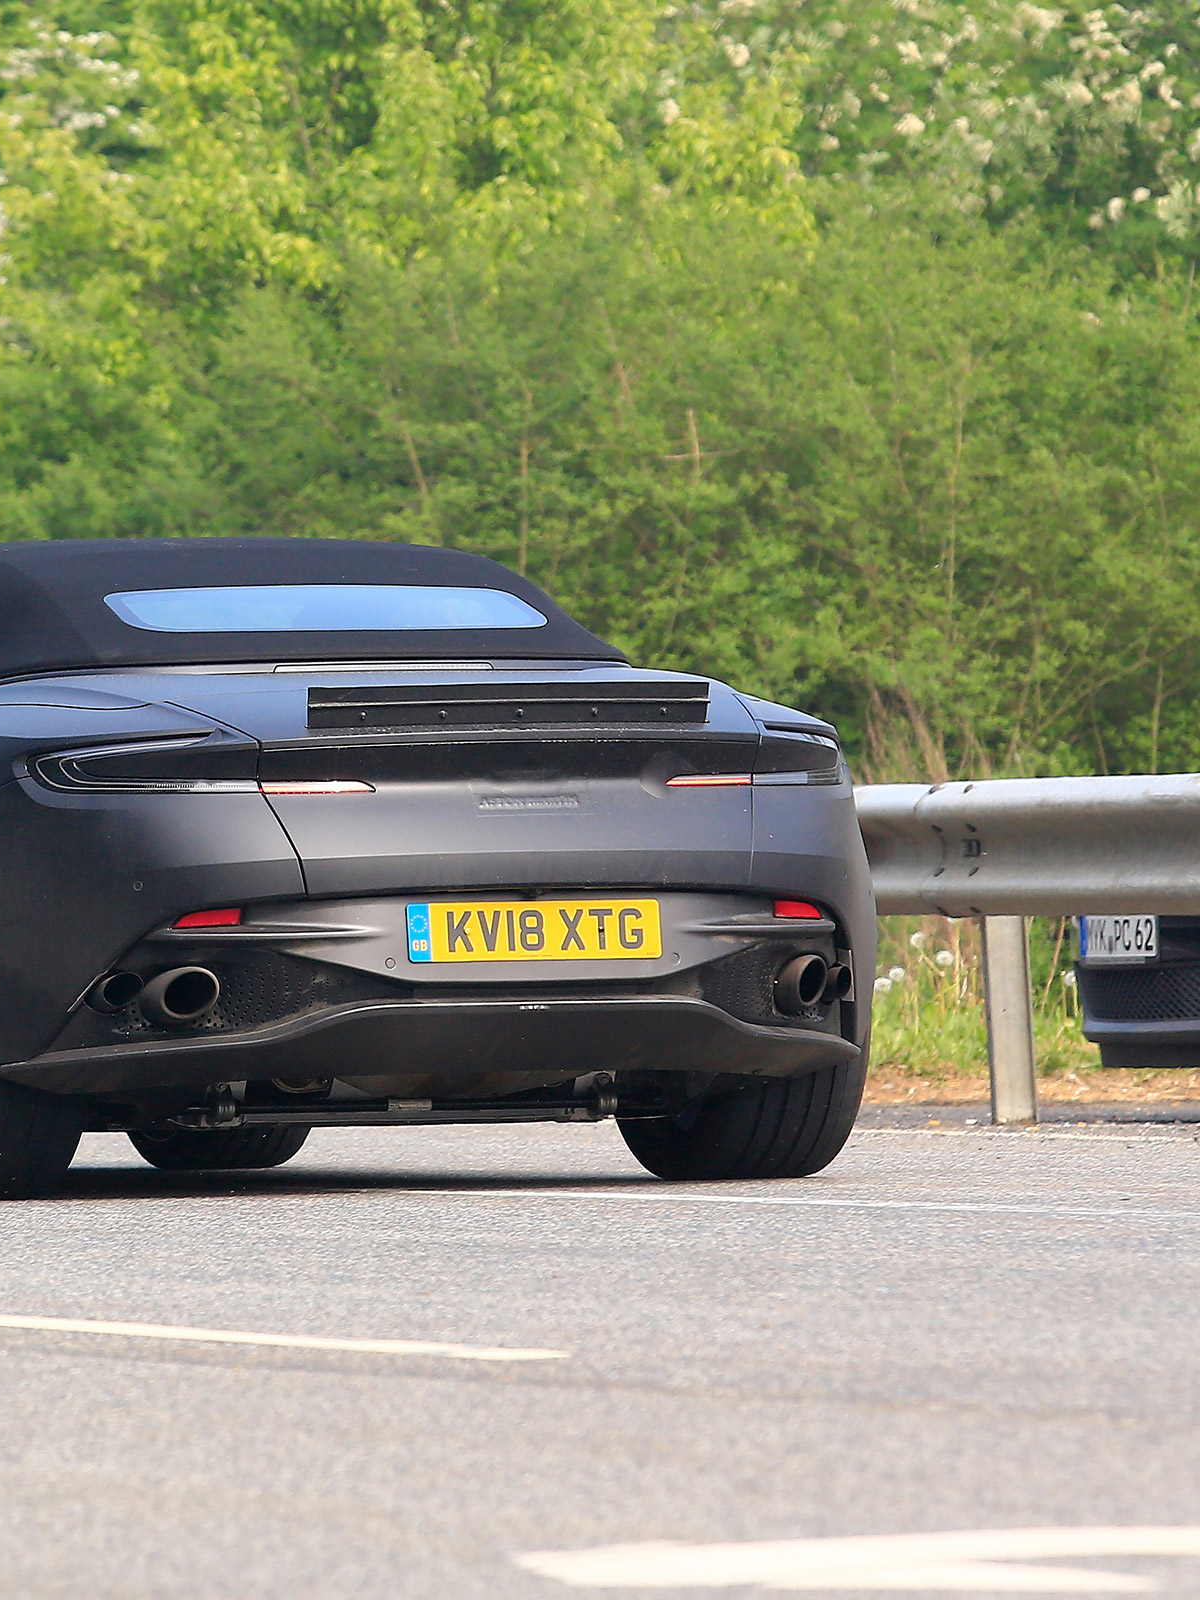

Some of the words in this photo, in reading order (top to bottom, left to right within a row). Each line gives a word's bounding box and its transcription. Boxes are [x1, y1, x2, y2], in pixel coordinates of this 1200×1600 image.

[412, 940, 428, 951] GB
[446, 909, 545, 953] KV18
[559, 907, 644, 951] XTG
[1114, 919, 1132, 951] PC
[1135, 918, 1154, 951] 62
